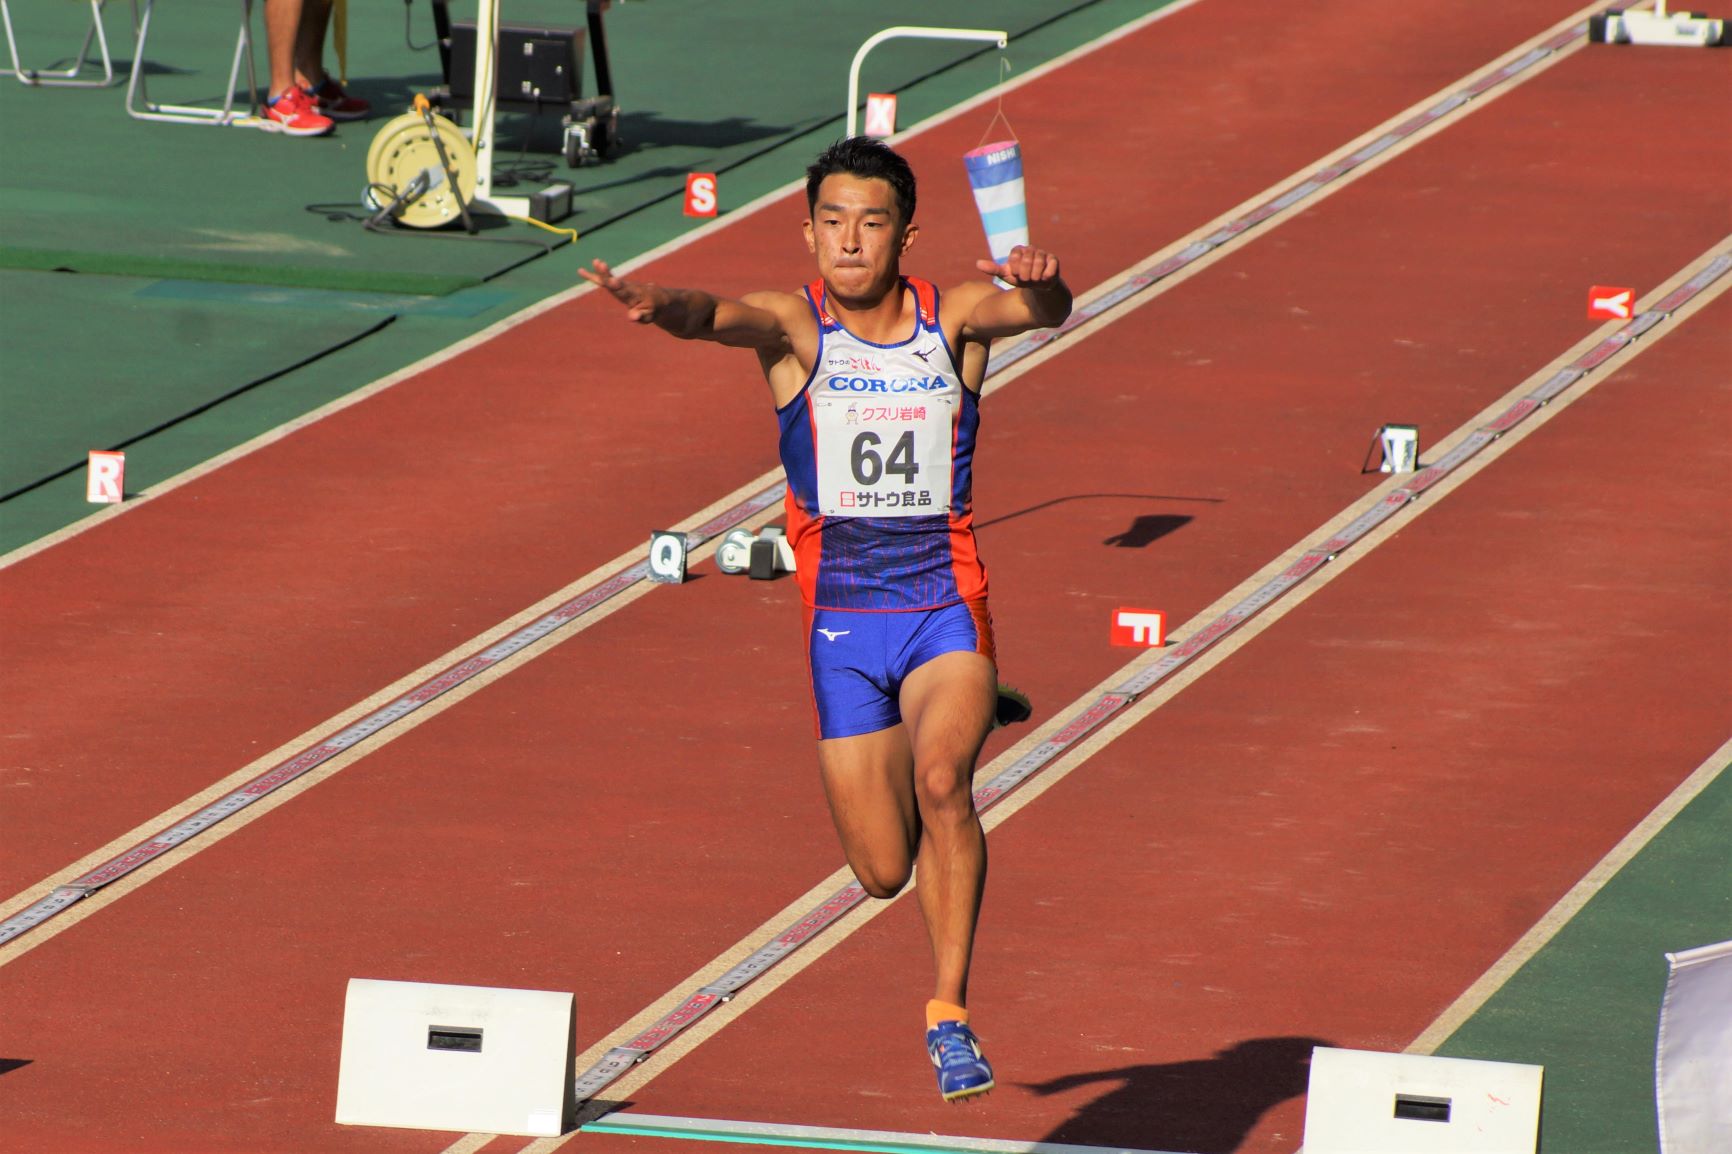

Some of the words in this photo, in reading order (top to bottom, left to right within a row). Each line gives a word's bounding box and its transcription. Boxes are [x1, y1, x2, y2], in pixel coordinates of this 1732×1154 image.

[868, 98, 893, 130] X
[986, 148, 1016, 165] NISHI
[691, 177, 716, 213] S
[1593, 290, 1630, 318] Y
[828, 375, 948, 393] CORONA
[862, 407, 926, 421] クスリ岩崎
[850, 430, 919, 486] 64
[88, 456, 121, 498] R
[857, 490, 932, 507] サトウ食品
[651, 535, 683, 578] Q
[1118, 612, 1161, 645] F
